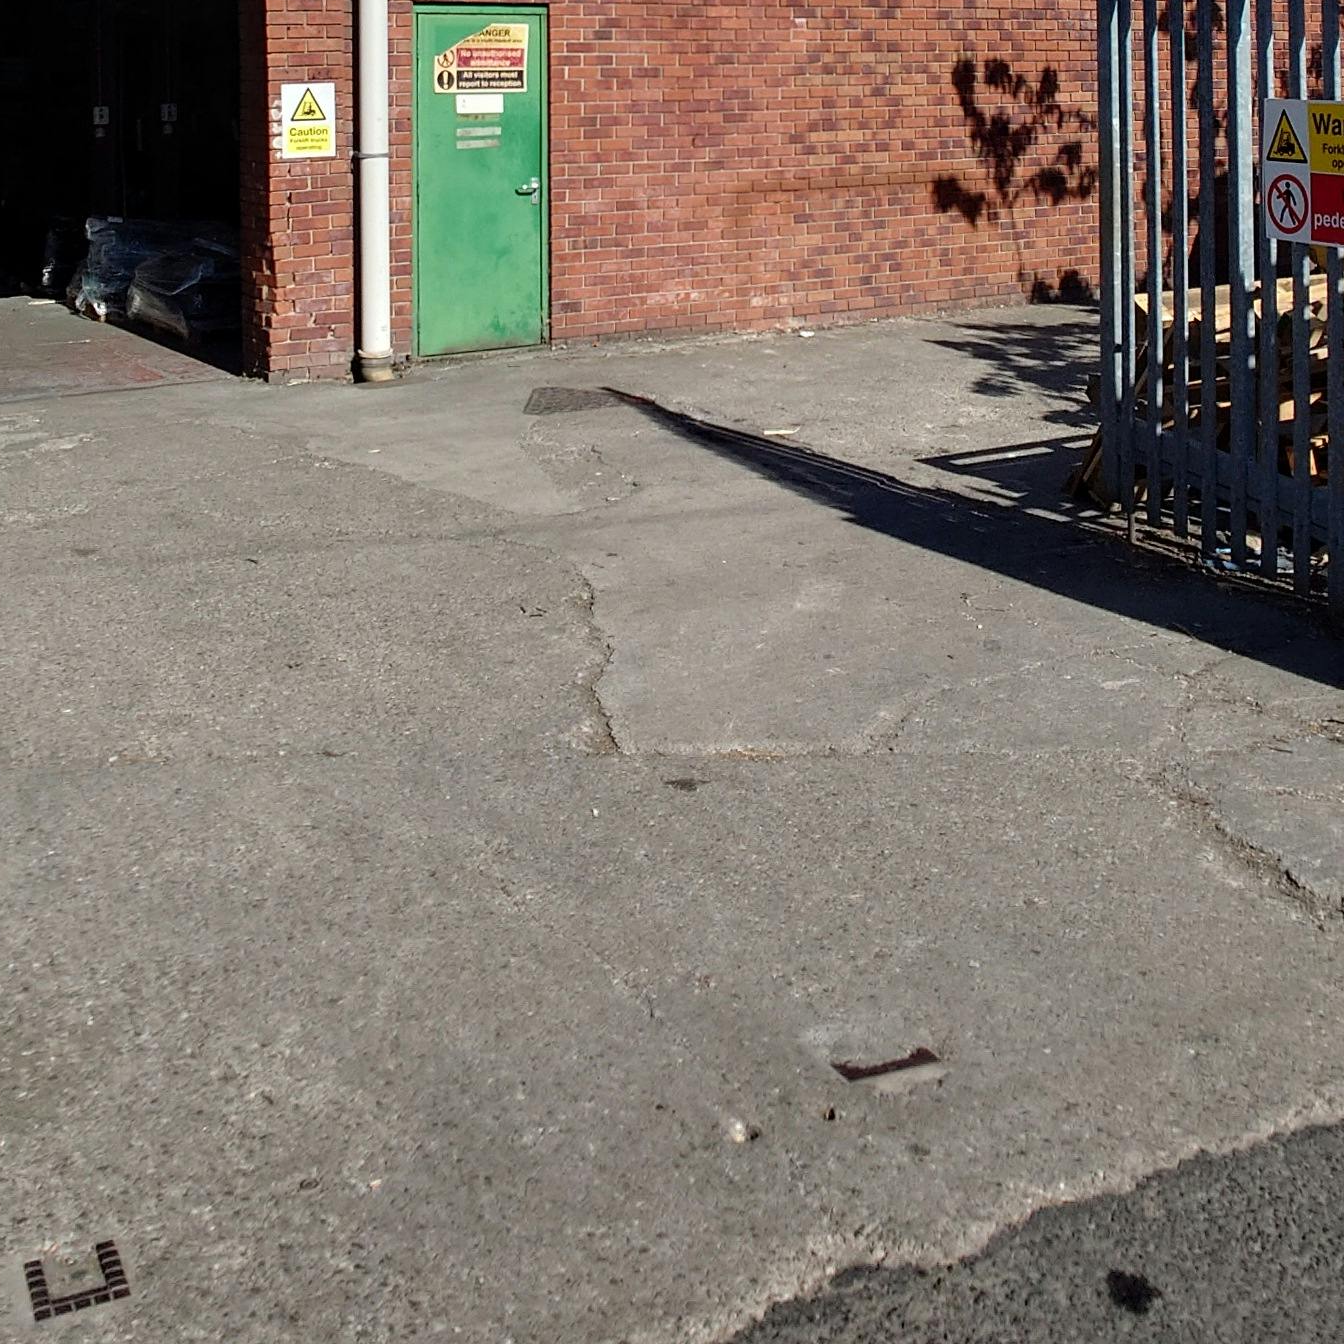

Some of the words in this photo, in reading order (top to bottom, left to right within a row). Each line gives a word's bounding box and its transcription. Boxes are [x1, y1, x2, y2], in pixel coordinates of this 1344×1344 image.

[481, 80, 489, 88] to
[489, 80, 522, 88] reception
[290, 127, 328, 136] Caution
